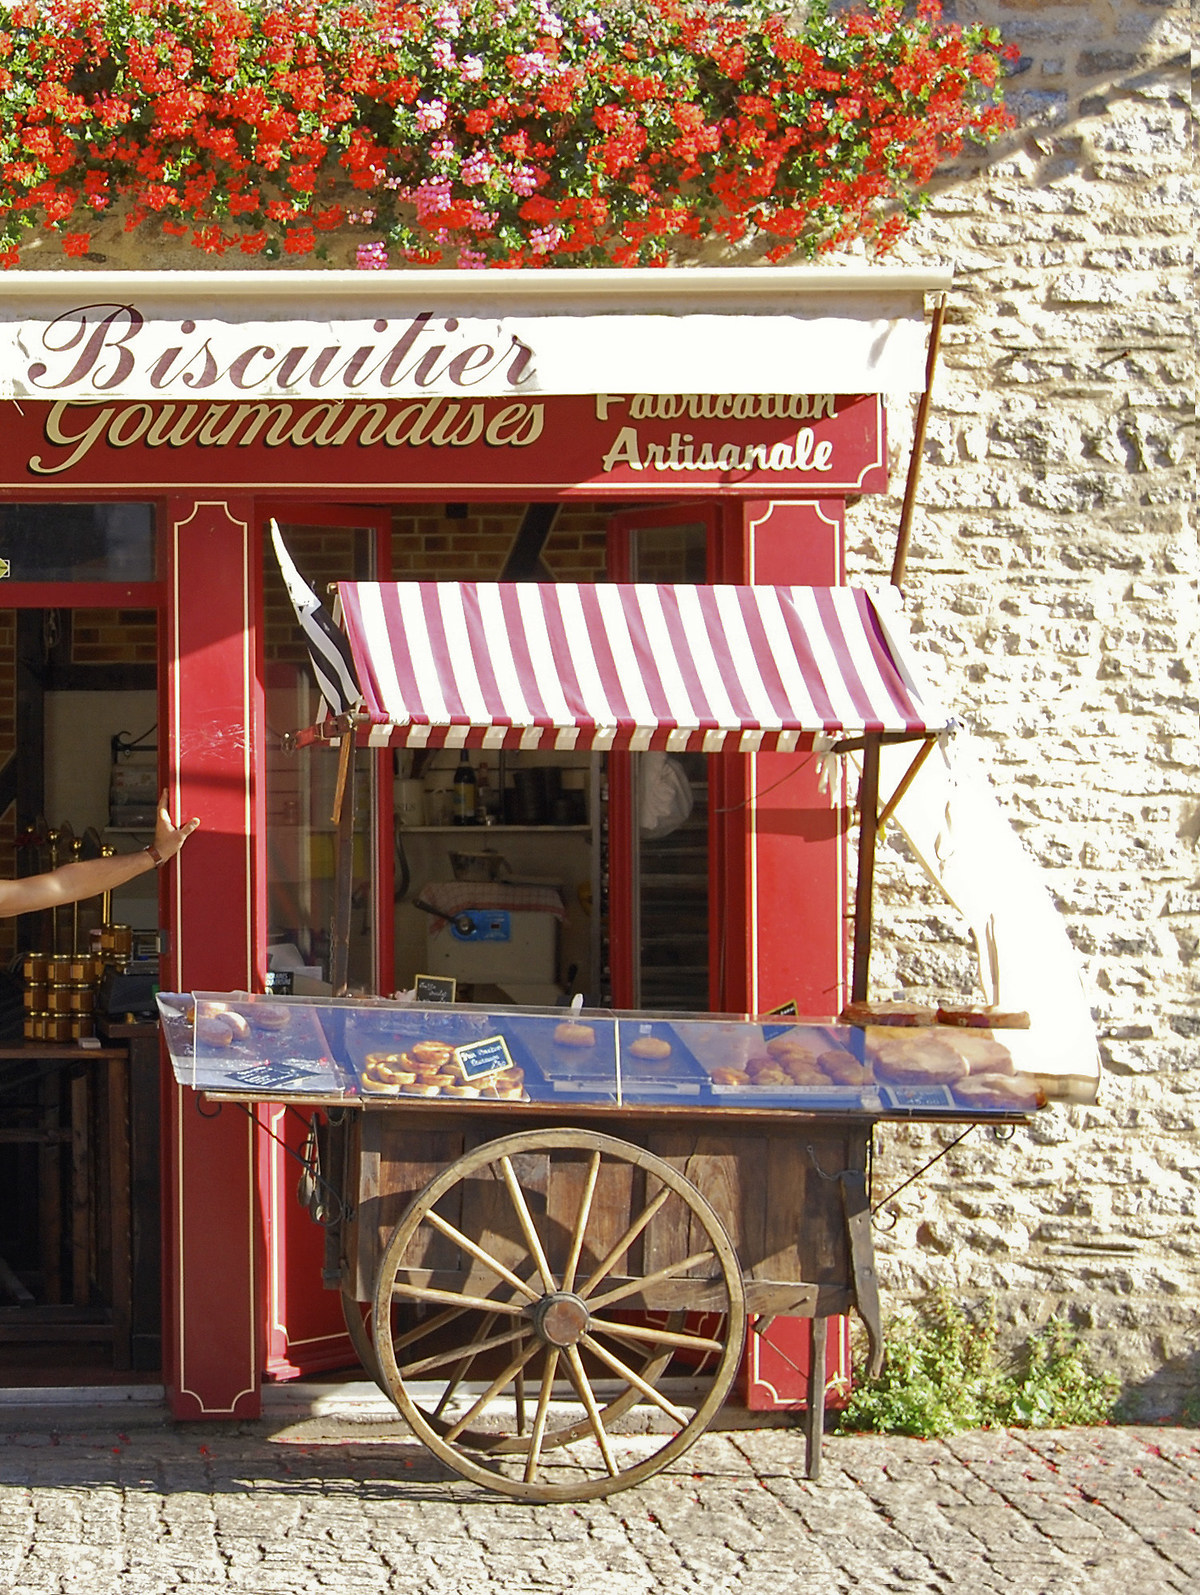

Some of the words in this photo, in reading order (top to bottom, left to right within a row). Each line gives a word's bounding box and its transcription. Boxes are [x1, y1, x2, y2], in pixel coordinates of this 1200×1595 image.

[27, 303, 538, 390] Biscuitier
[27, 398, 545, 476] Gourmandises
[602, 426, 834, 472] Artisanale
